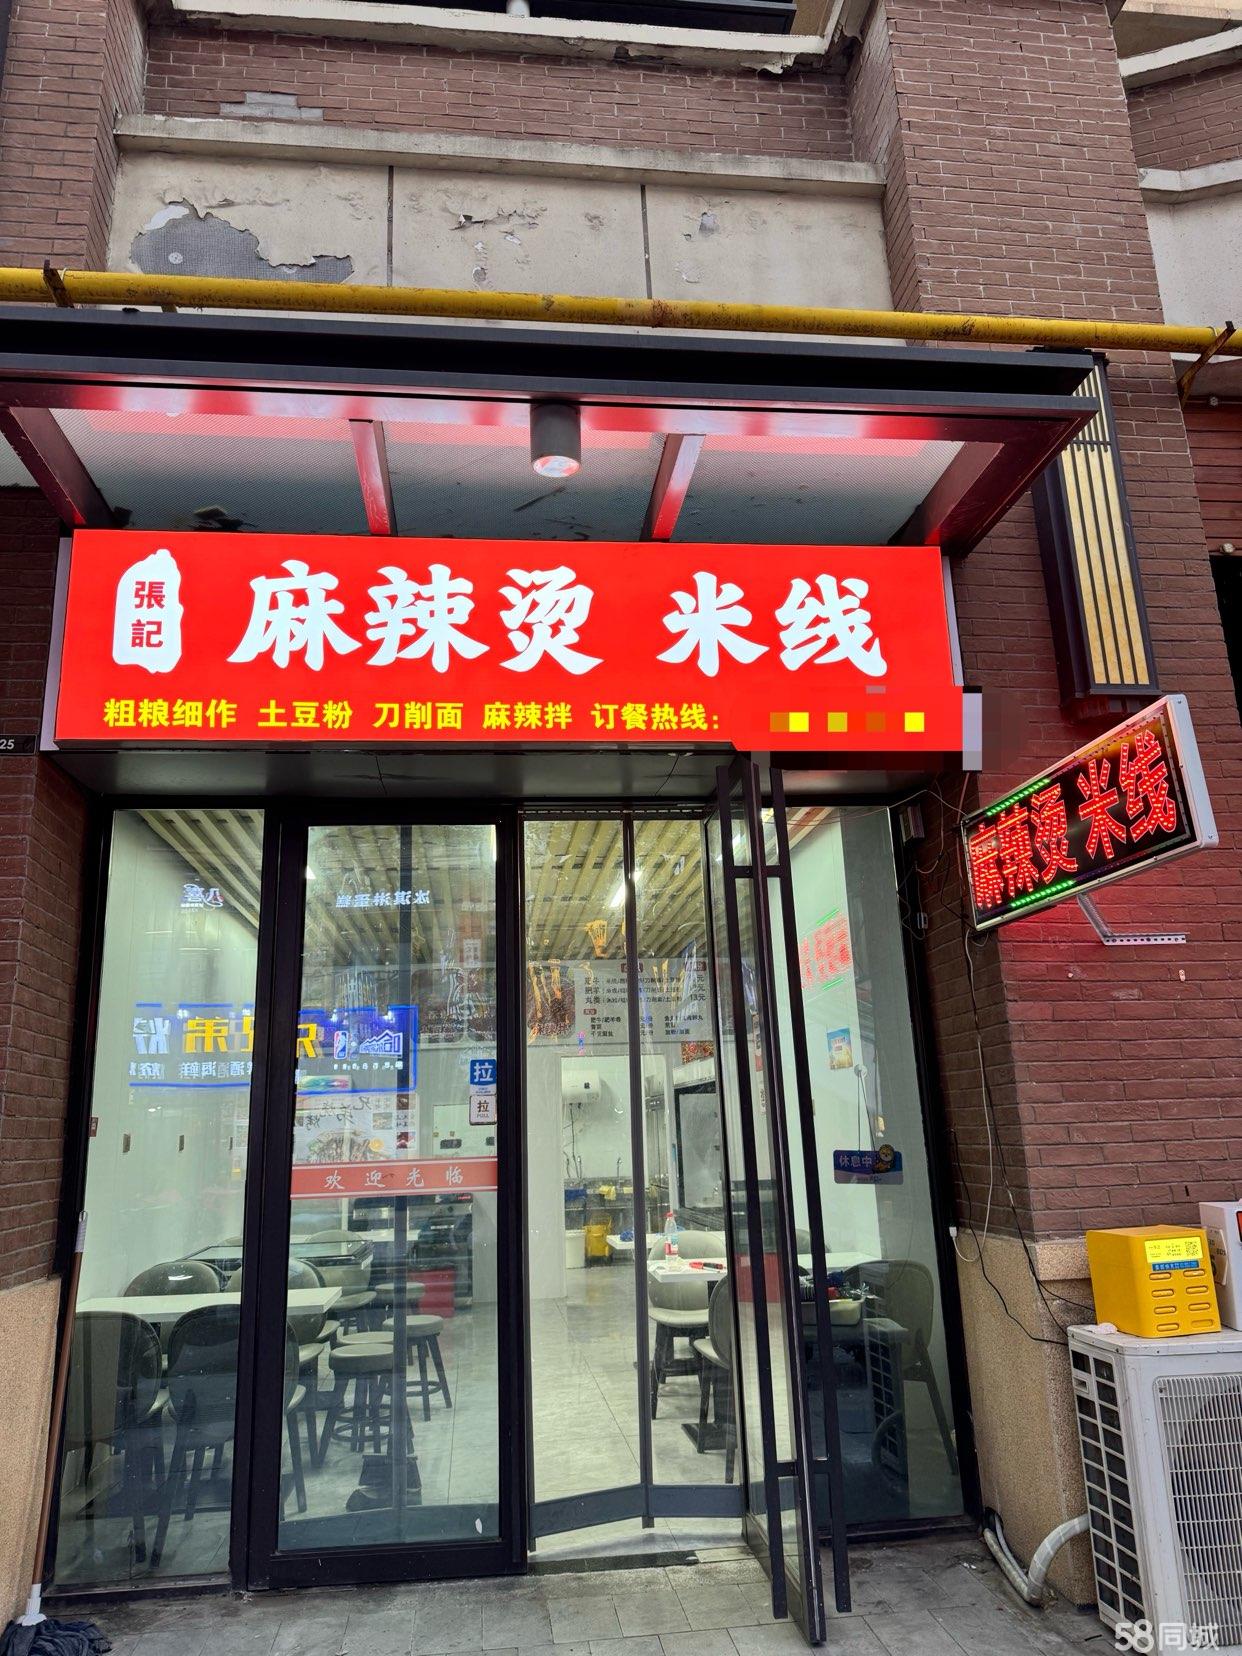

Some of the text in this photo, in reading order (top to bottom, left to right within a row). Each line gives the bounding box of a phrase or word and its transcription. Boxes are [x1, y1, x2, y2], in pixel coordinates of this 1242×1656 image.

[131, 580, 166, 648] 張記
[226, 559, 888, 678] 麻辣烫 米线
[103, 698, 238, 729] 粗粮细作
[257, 699, 353, 730] 土豆粉
[372, 701, 464, 730] 刀削面
[482, 701, 573, 730] 麻辣拌
[970, 729, 1177, 909] 麻辣烫 米线
[473, 1062, 494, 1082] 拉
[476, 1100, 490, 1113] 拉
[839, 1155, 873, 1168] 休息中
[323, 1166, 464, 1190] 欢迎光临
